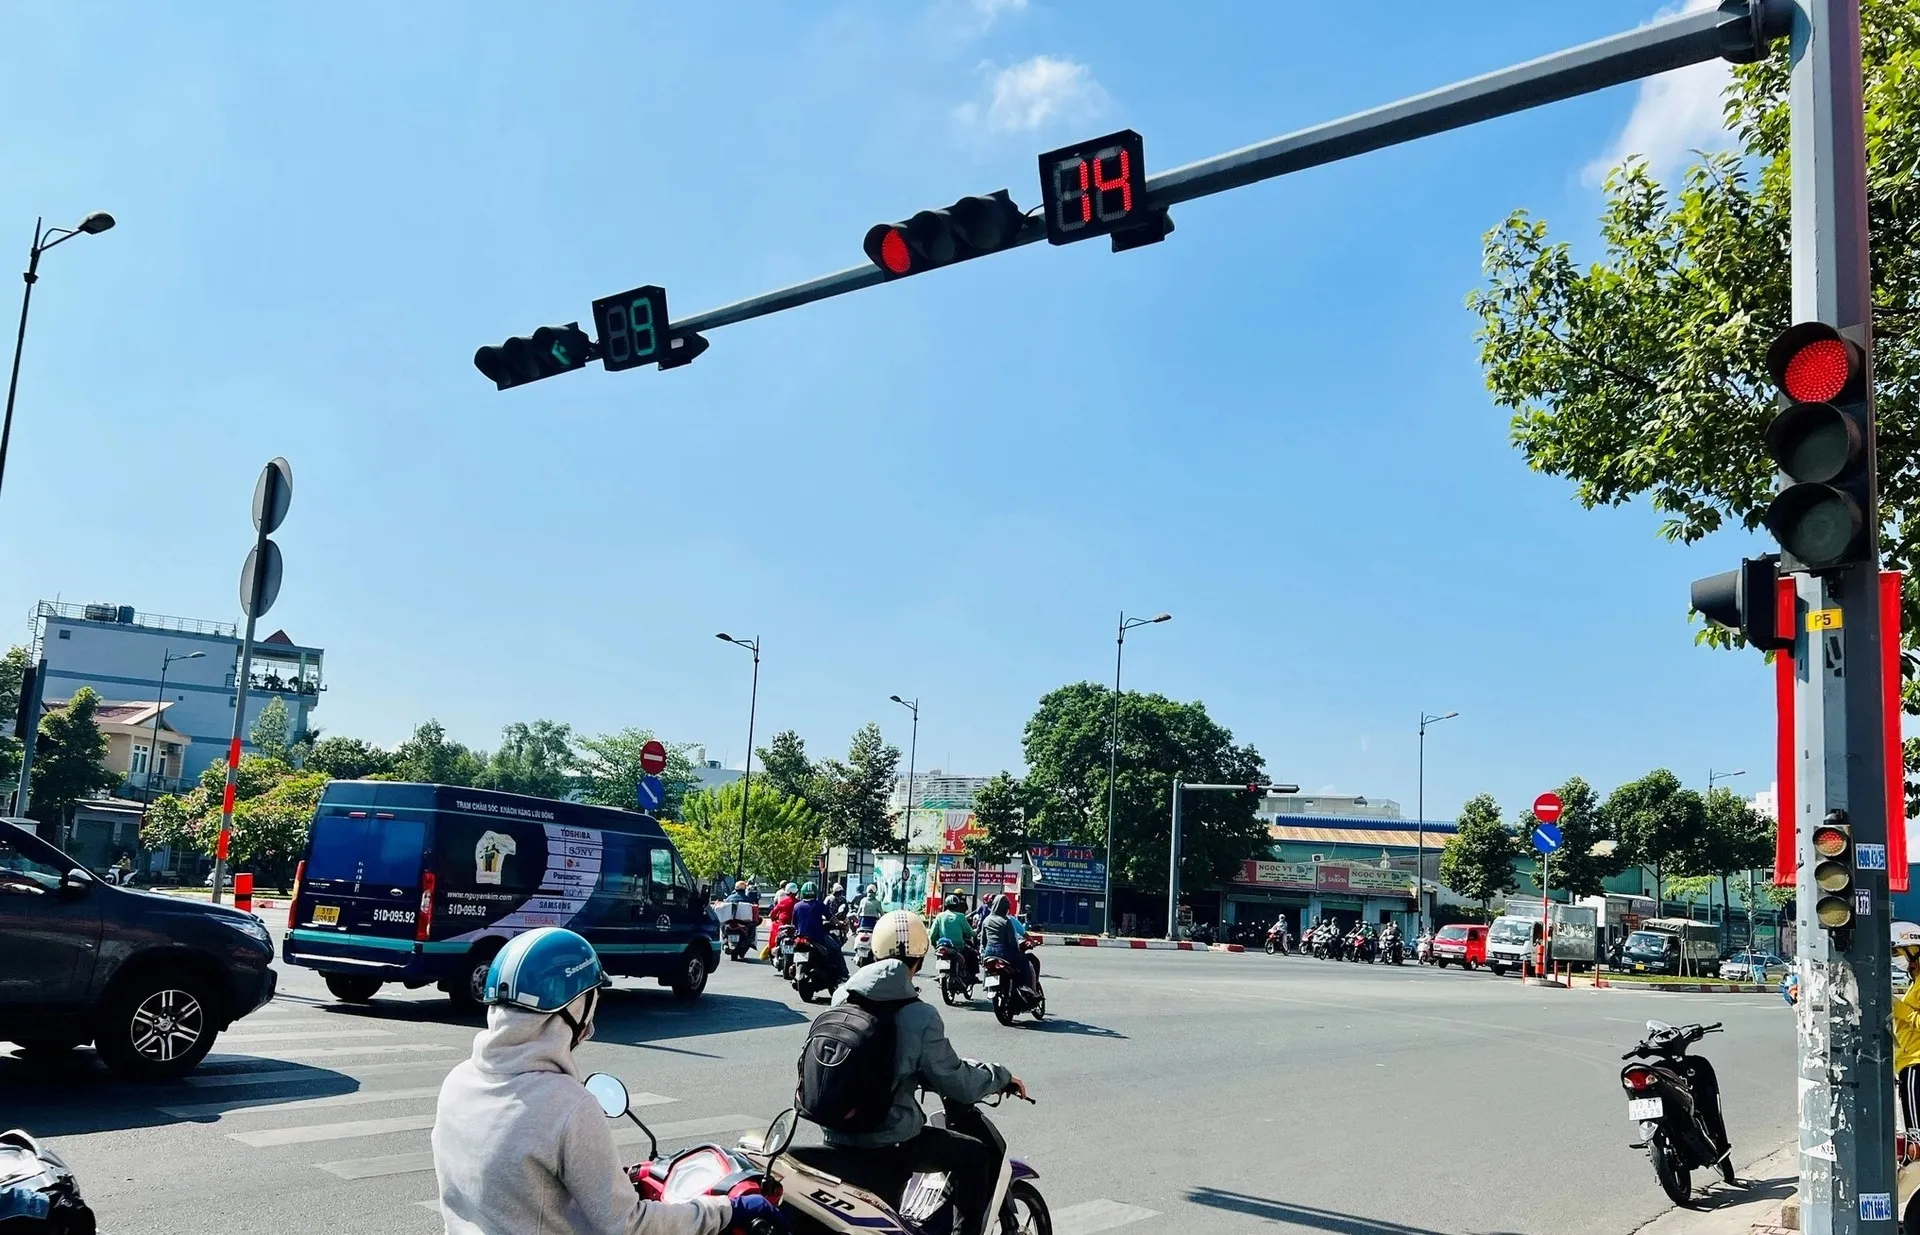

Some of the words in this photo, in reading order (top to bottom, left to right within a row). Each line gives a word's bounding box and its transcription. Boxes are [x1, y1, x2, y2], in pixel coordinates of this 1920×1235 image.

[1078, 149, 1133, 223] 14
[1814, 613, 1832, 627] P5
[560, 829, 591, 839] TOSHIBA
[569, 847, 593, 856] SONY
[447, 892, 513, 901] www.nguyenkim.com
[448, 904, 487, 916] 51D-095.92
[539, 901, 571, 910] SAMSUNG
[373, 909, 416, 923] 51D-095.92
